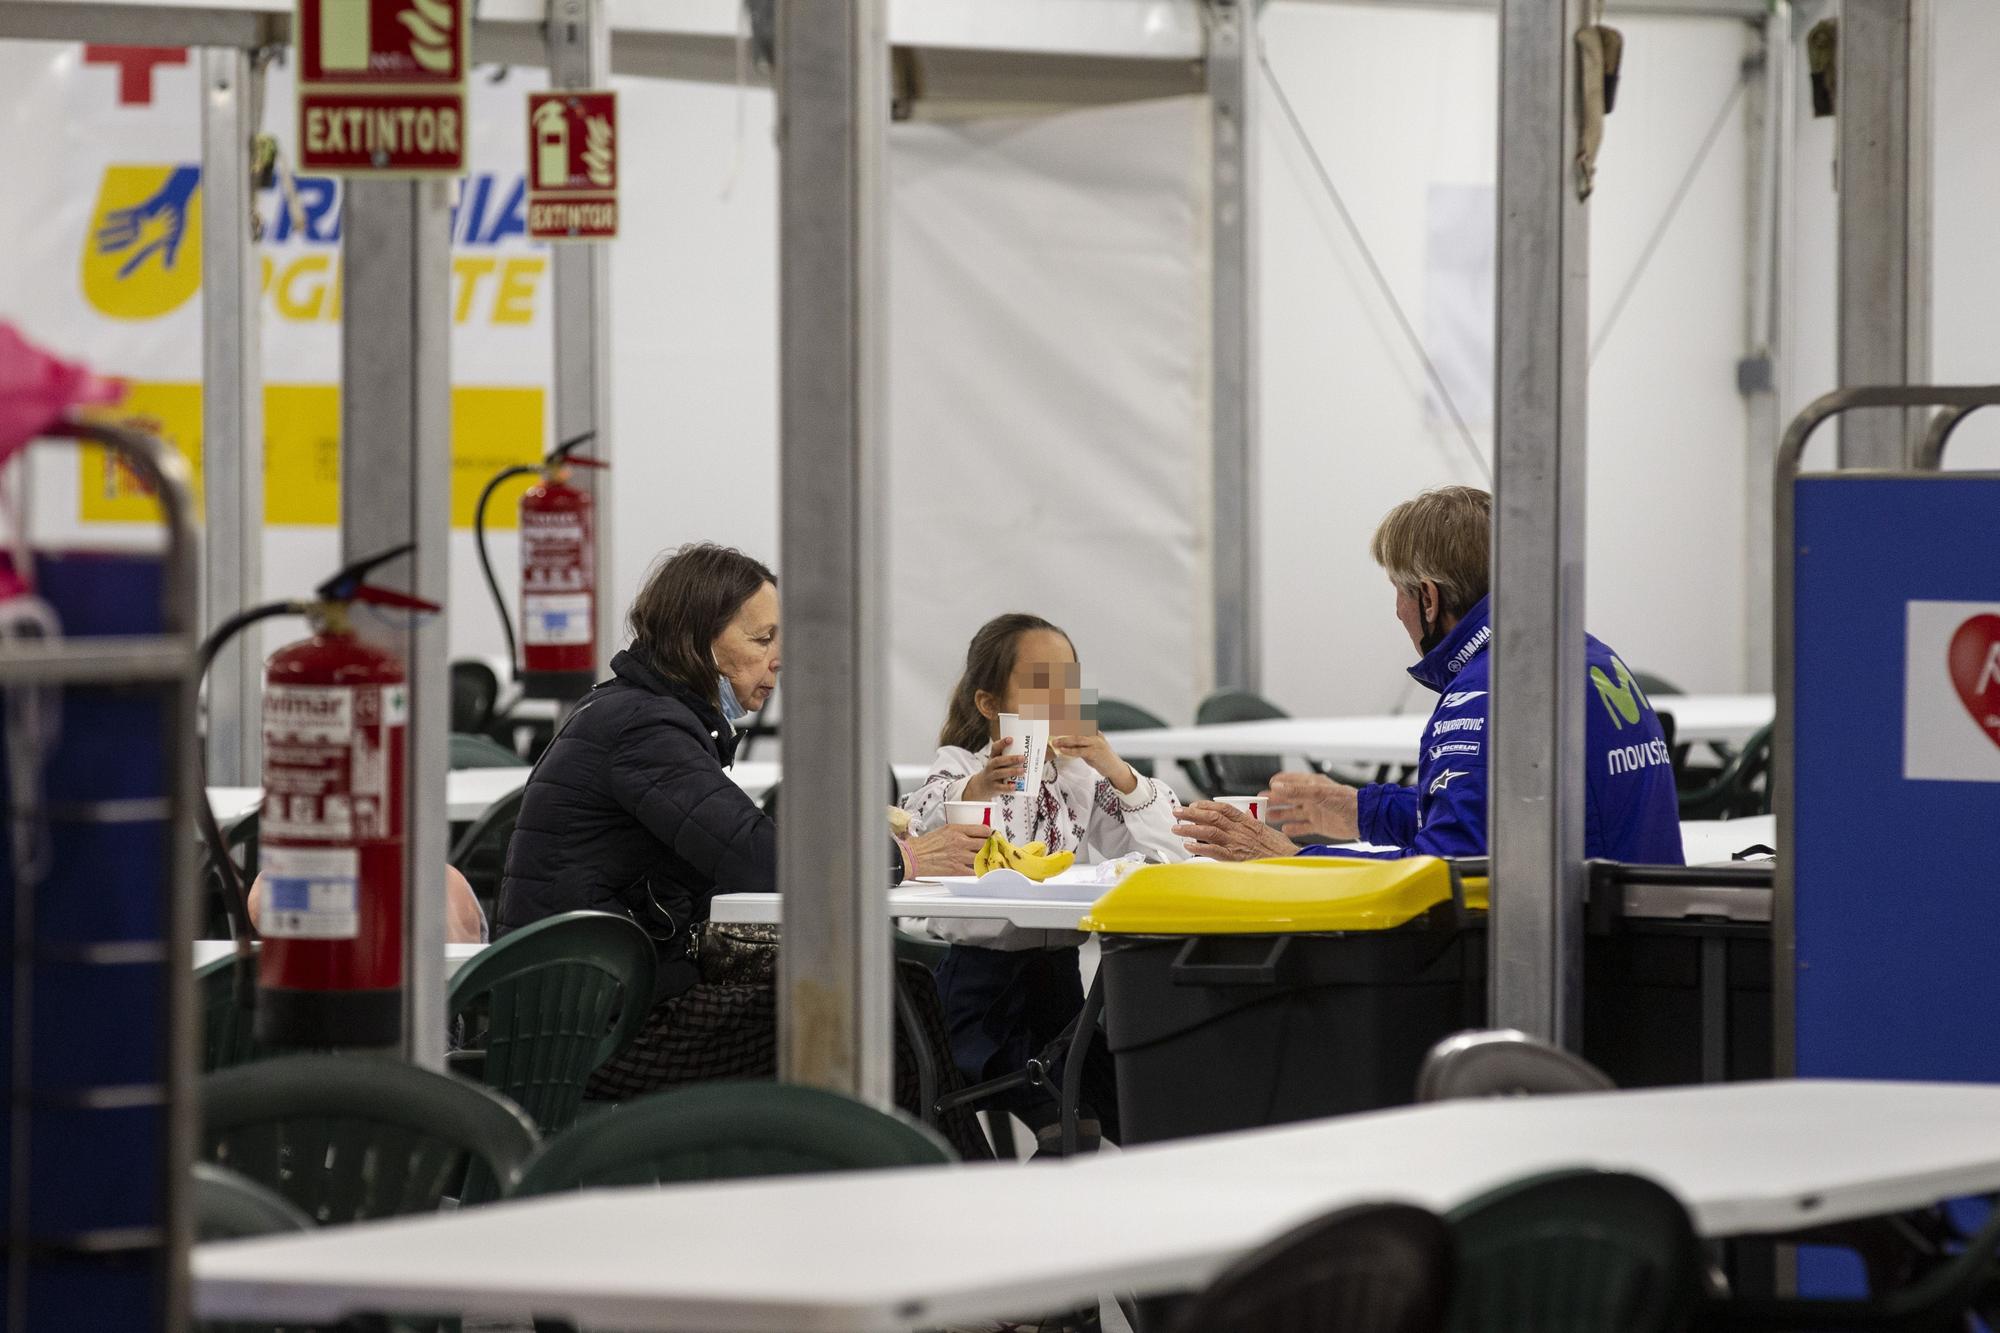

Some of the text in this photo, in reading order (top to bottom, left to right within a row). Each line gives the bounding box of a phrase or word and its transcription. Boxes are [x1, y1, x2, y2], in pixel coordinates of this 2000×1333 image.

[306, 106, 458, 152] EXTINTOR
[531, 203, 614, 230] EXTINTOR
[1454, 625, 1492, 664] YAMAHA
[1441, 744, 1478, 752] MICHELIN
